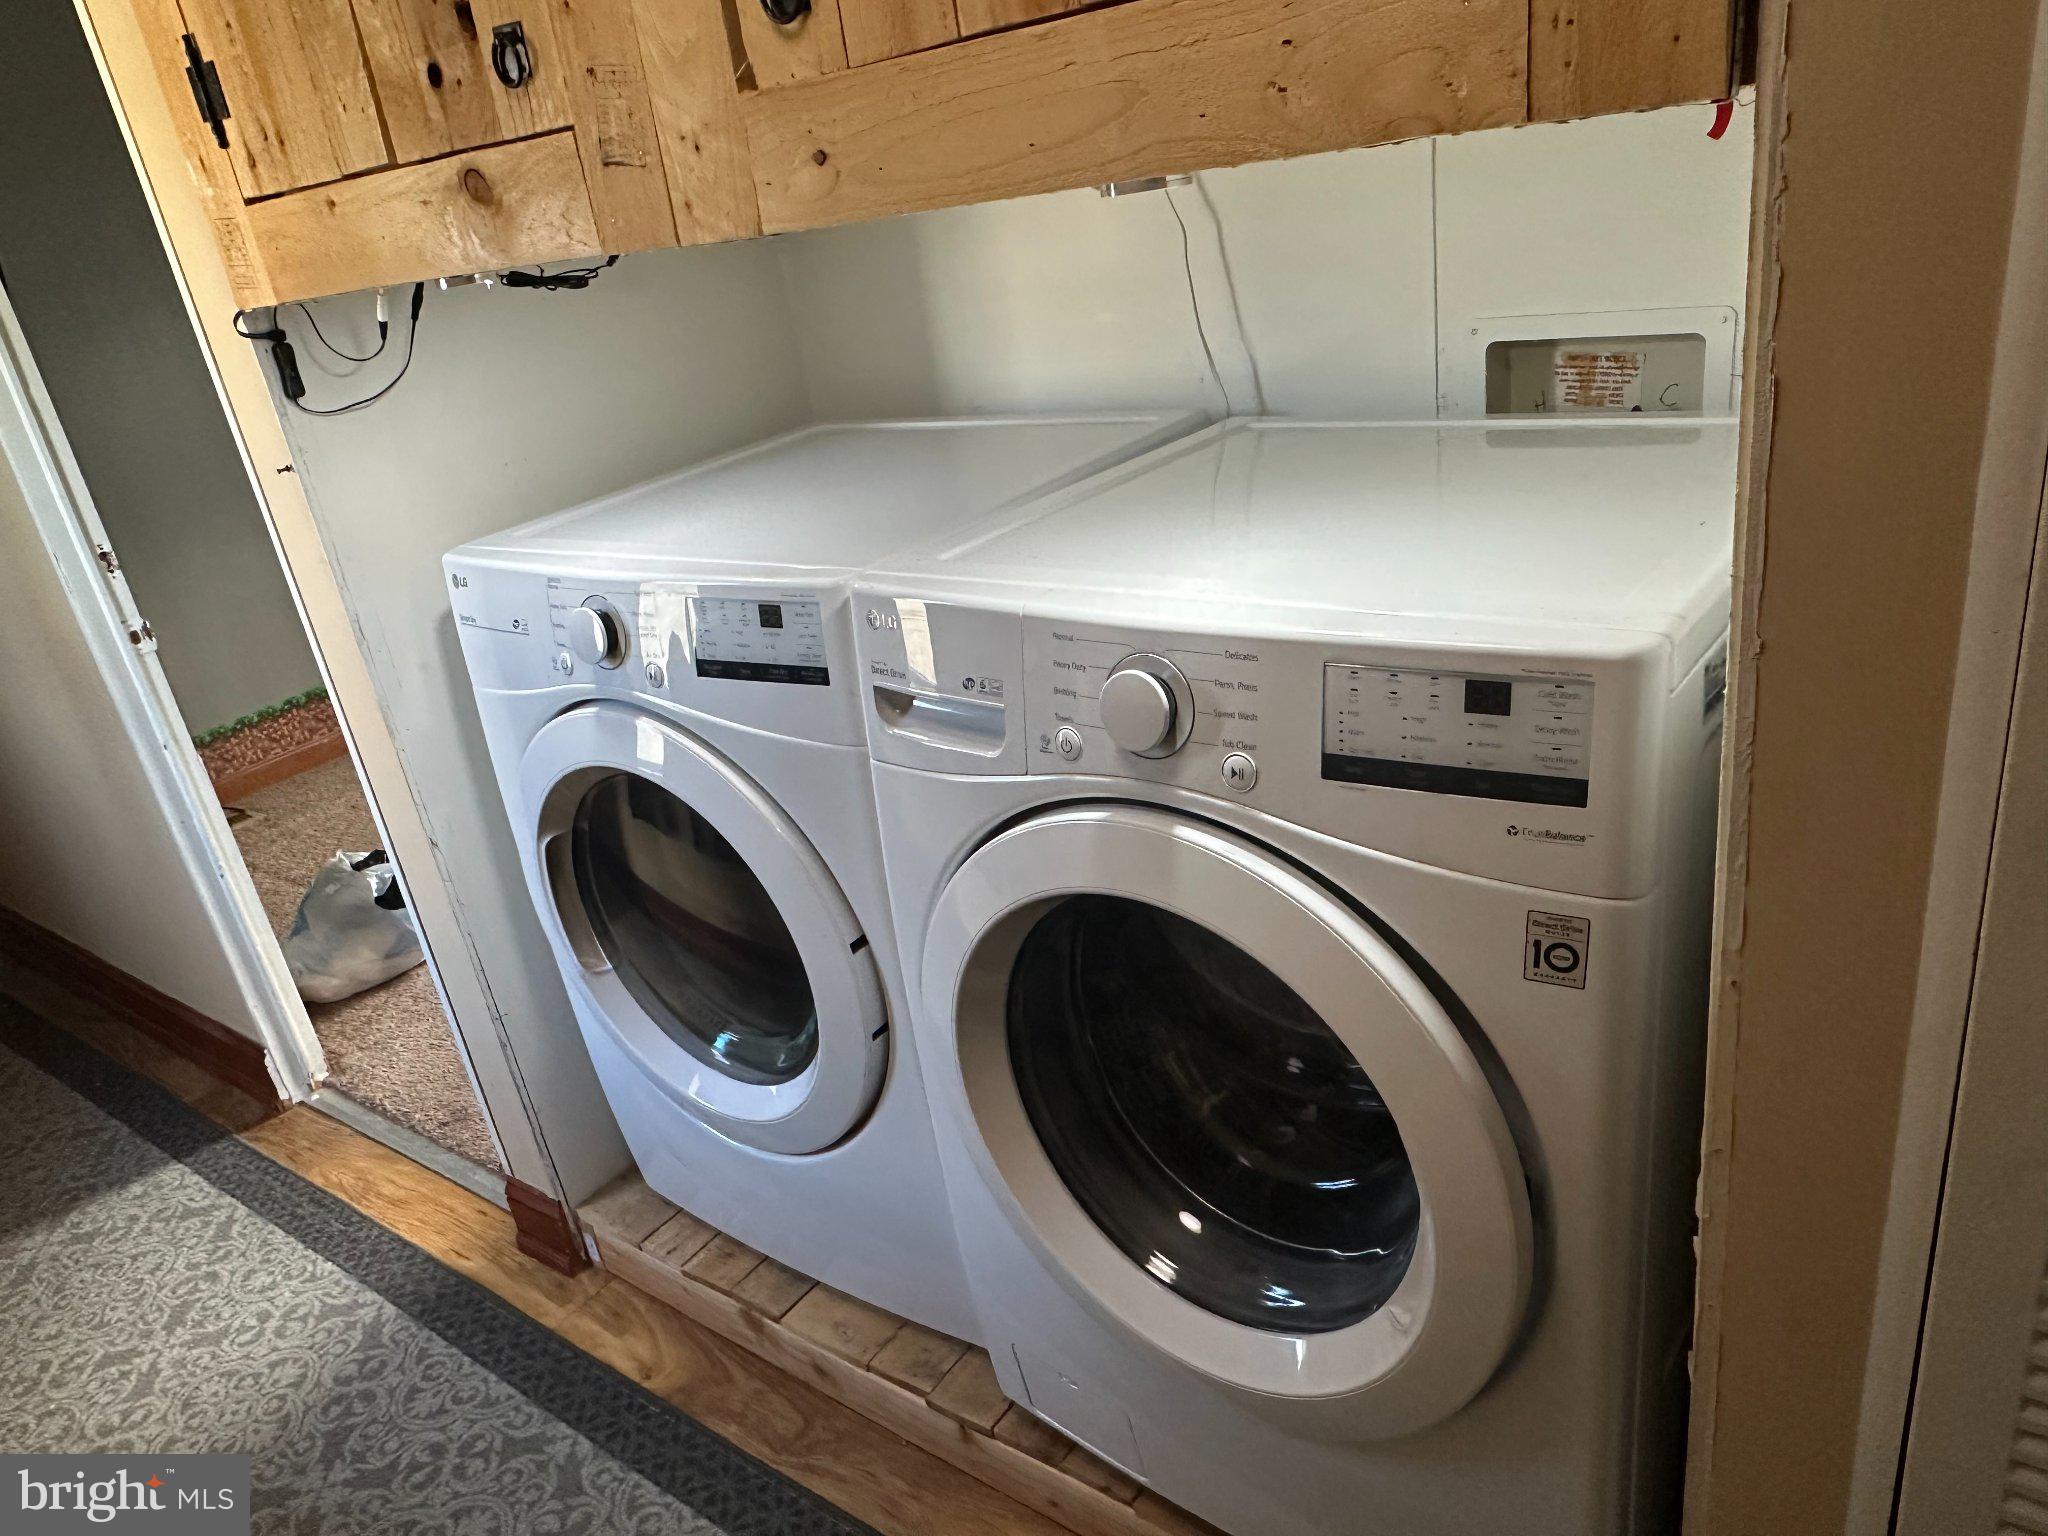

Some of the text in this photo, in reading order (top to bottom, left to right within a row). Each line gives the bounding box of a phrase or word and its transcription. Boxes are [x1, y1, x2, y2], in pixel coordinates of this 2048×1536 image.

[1659, 383, 1679, 407] C
[1224, 650, 1259, 662] Delicates
[1533, 938, 1580, 974] 10
